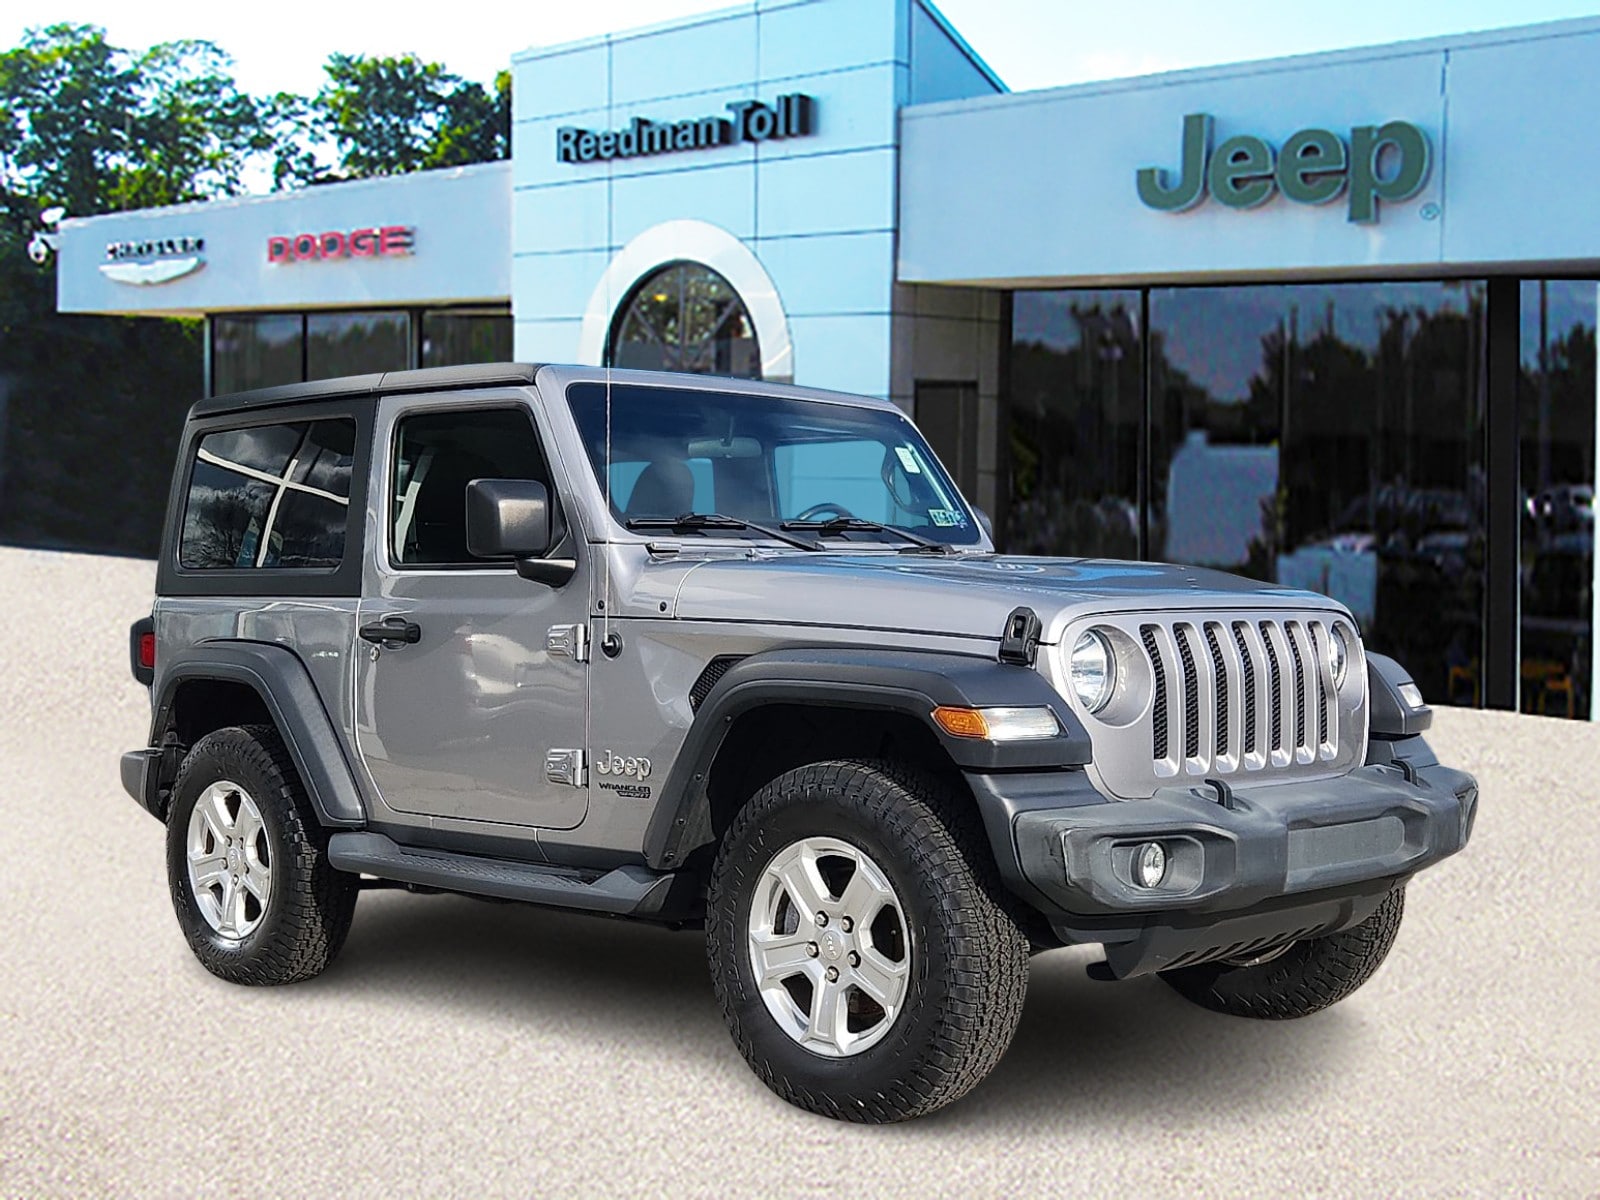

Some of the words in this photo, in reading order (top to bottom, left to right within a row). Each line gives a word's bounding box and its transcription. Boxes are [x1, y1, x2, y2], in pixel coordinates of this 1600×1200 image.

[557, 117, 724, 163] Reedman
[726, 93, 811, 142] Toll
[1136, 113, 1433, 224] Jeep
[268, 225, 413, 263] DODGE
[597, 749, 651, 781] Jeep
